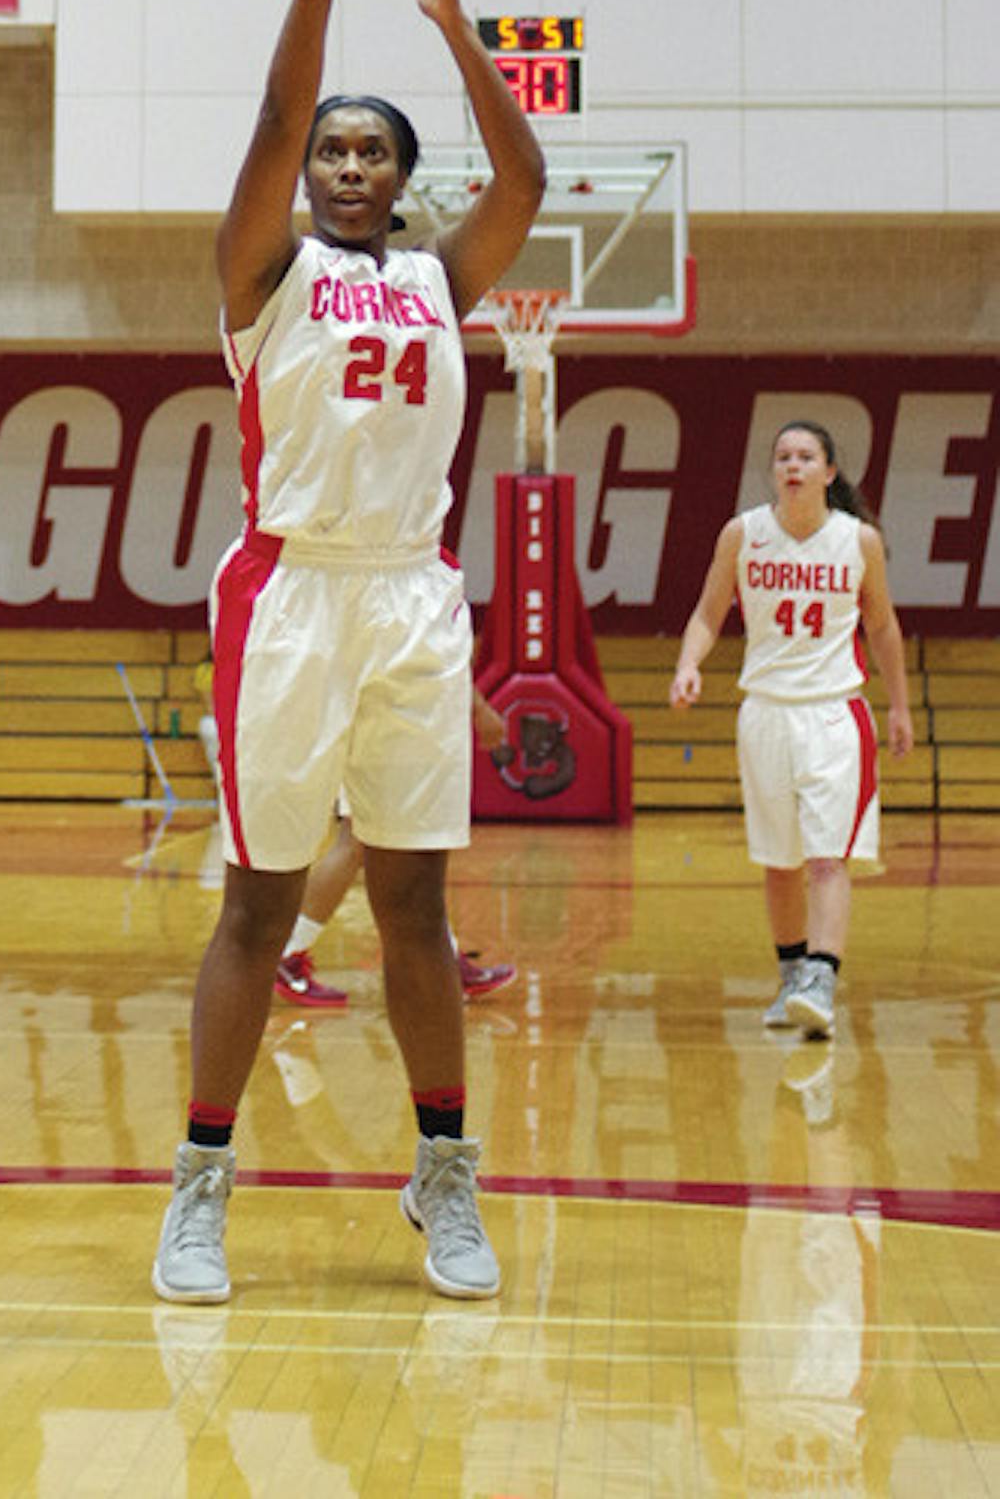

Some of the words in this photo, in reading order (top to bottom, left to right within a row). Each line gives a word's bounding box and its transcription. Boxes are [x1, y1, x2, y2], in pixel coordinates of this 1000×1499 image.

[343, 335, 427, 405] 24
[456, 387, 681, 607] IG
[733, 392, 1000, 608] RE
[747, 560, 852, 593] CORNELL
[775, 598, 824, 638] 44
